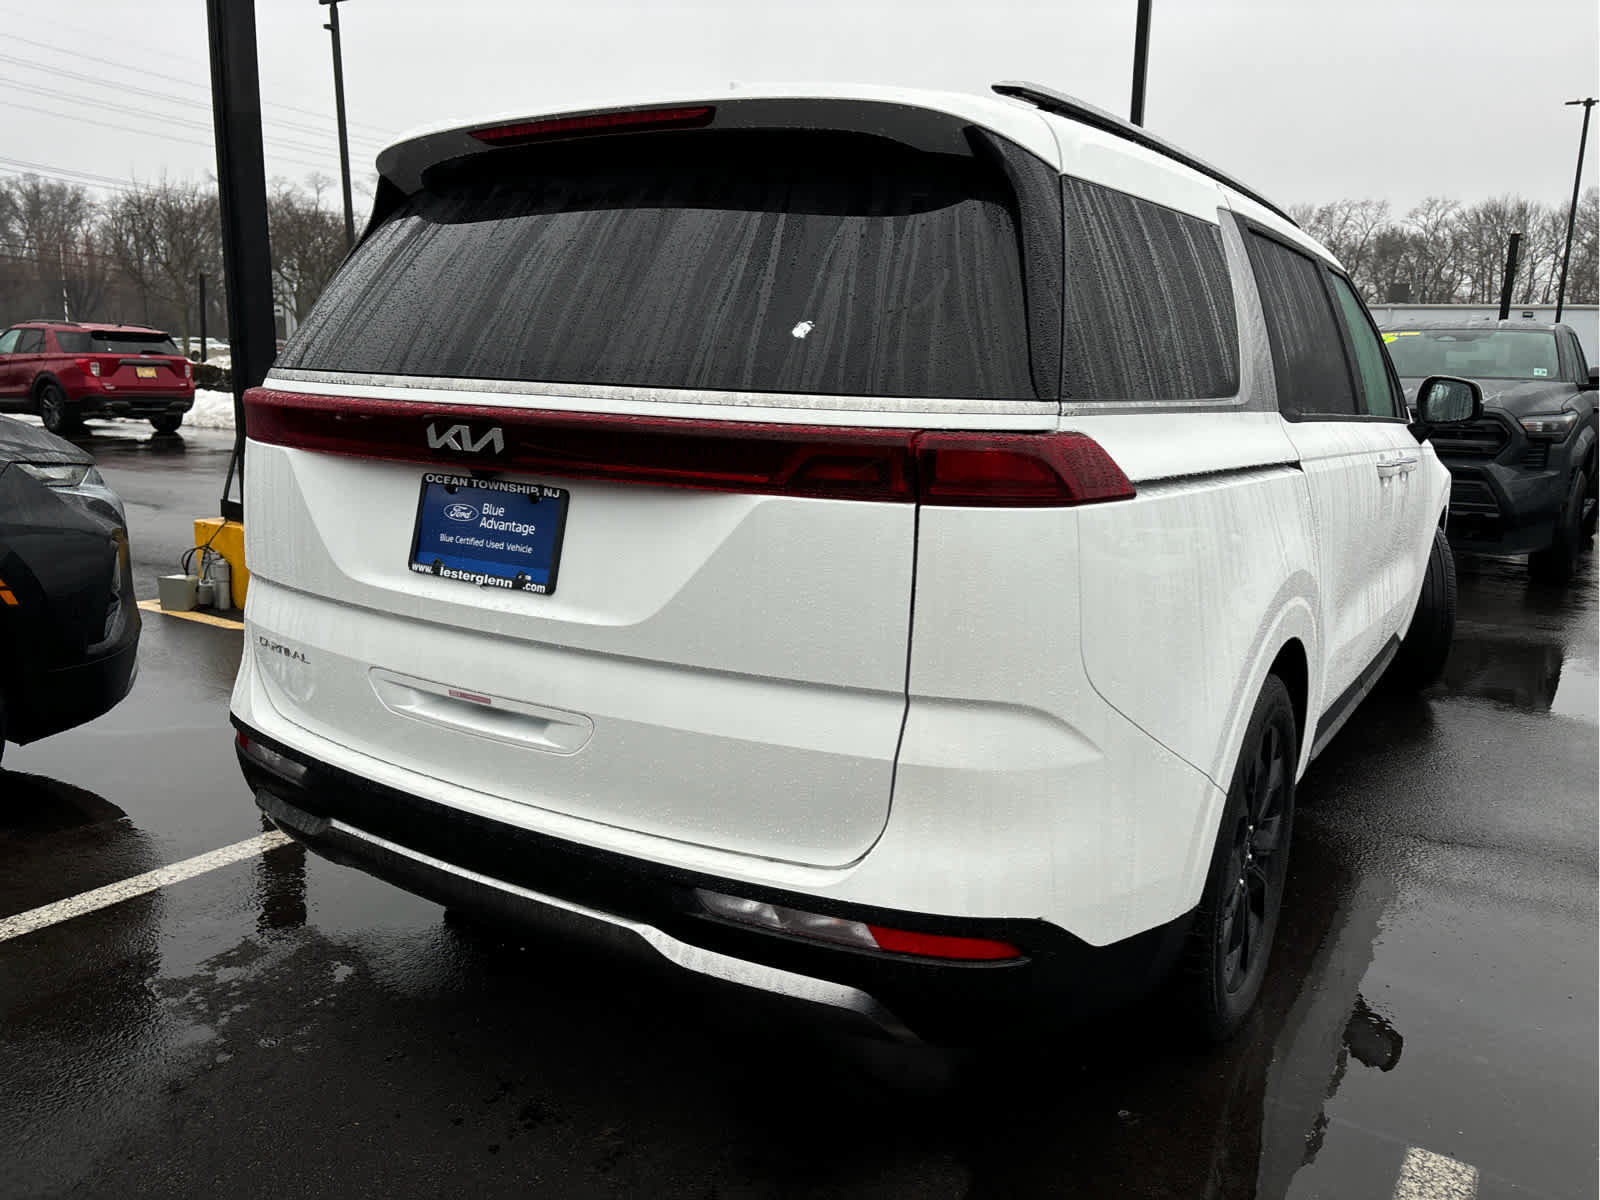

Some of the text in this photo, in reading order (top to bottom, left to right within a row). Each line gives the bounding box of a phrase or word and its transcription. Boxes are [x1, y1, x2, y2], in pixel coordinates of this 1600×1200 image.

[426, 423, 505, 454] KIA
[425, 473, 469, 487] OCEAN
[543, 488, 561, 498] NJ
[449, 505, 472, 519] Ford
[482, 503, 505, 517] Blue
[479, 517, 536, 536] Advantage
[439, 533, 533, 554] Blue Certified Used Vehicle
[439, 566, 513, 588] lesterglenn
[522, 581, 546, 594] .com
